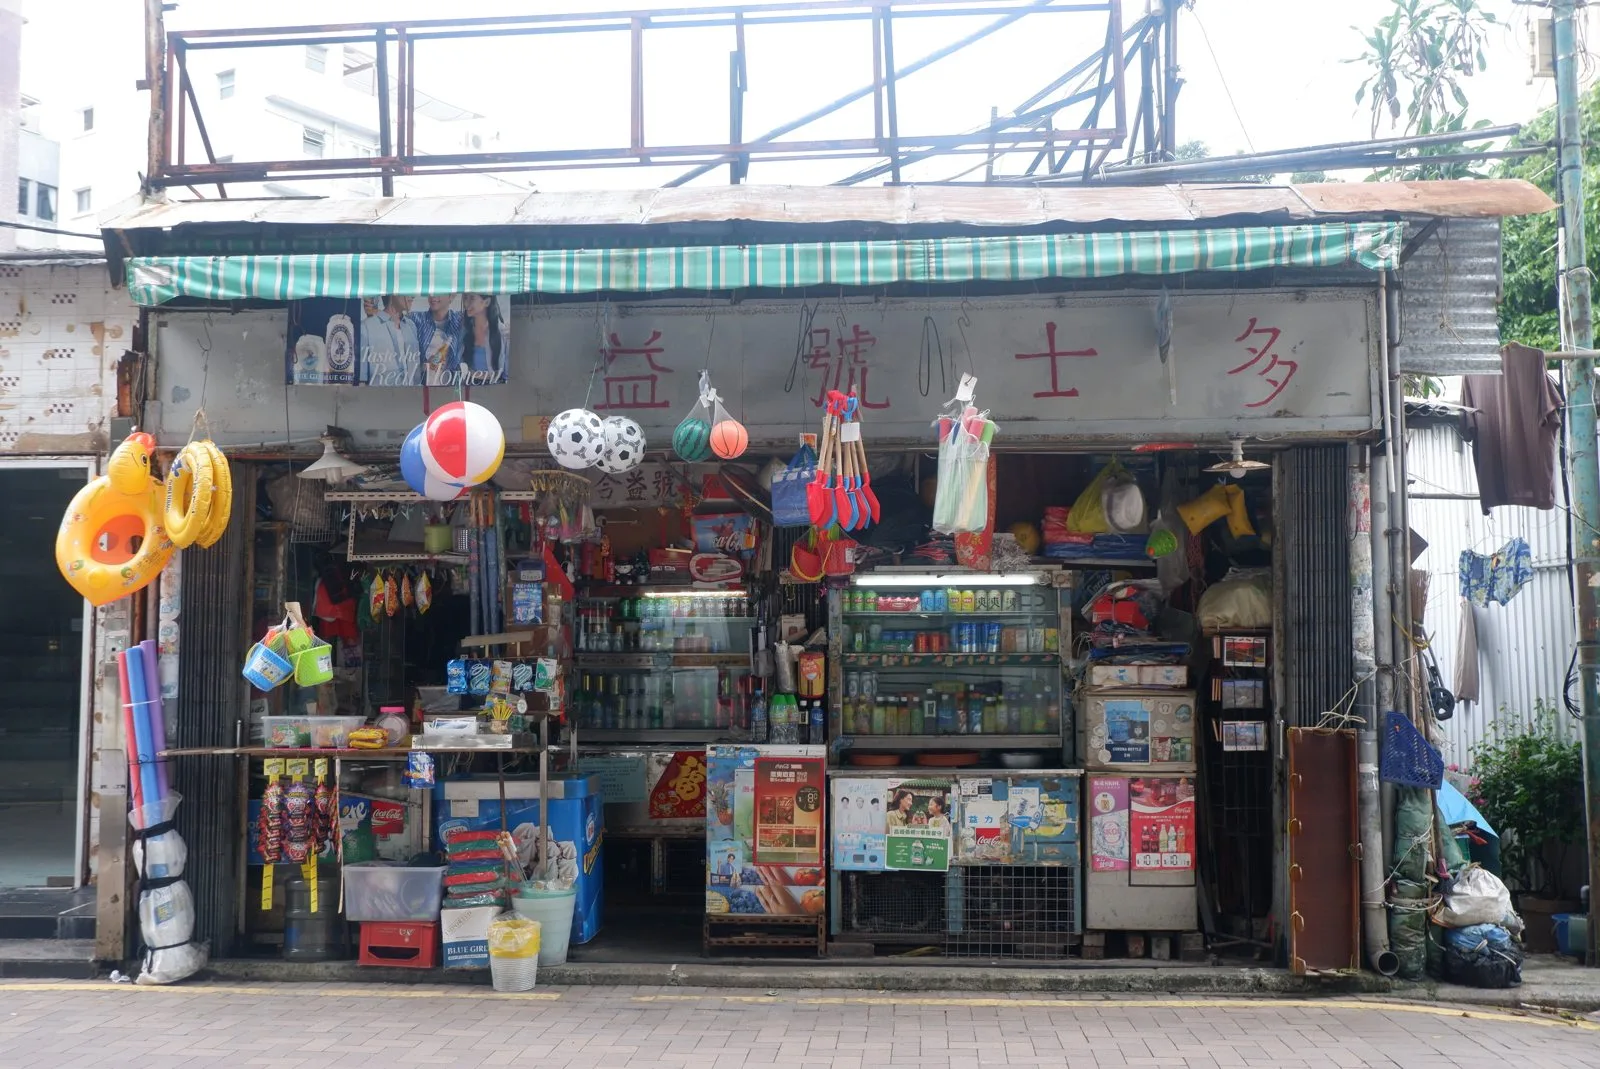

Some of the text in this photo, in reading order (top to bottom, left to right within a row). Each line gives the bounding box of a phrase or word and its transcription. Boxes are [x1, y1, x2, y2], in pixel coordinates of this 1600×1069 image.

[360, 345, 421, 364] Taste the
[369, 362, 505, 387] Real Moment
[447, 944, 488, 955] BLUE GIRL
